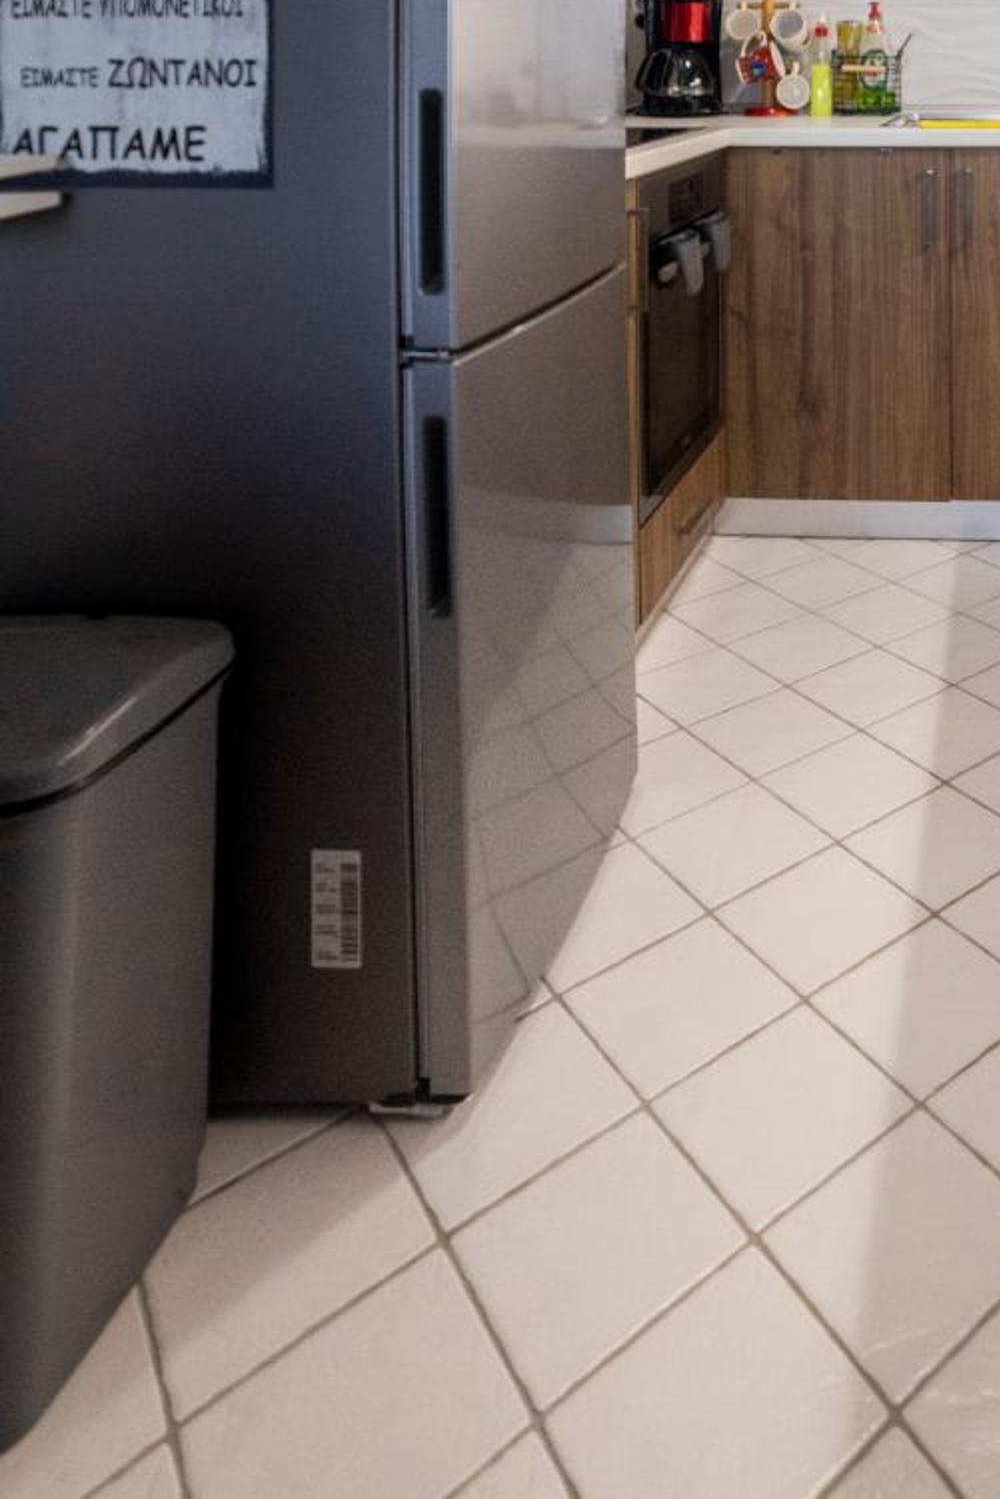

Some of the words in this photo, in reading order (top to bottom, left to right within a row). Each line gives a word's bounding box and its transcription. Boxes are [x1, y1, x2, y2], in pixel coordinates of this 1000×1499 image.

[20, 66, 99, 88] ΕΙΜΑΣΤΕ
[107, 55, 257, 89] ΖΩΝΤΑΝΟΙ
[12, 124, 207, 162] ΑΓΑΠΑΜΕ
